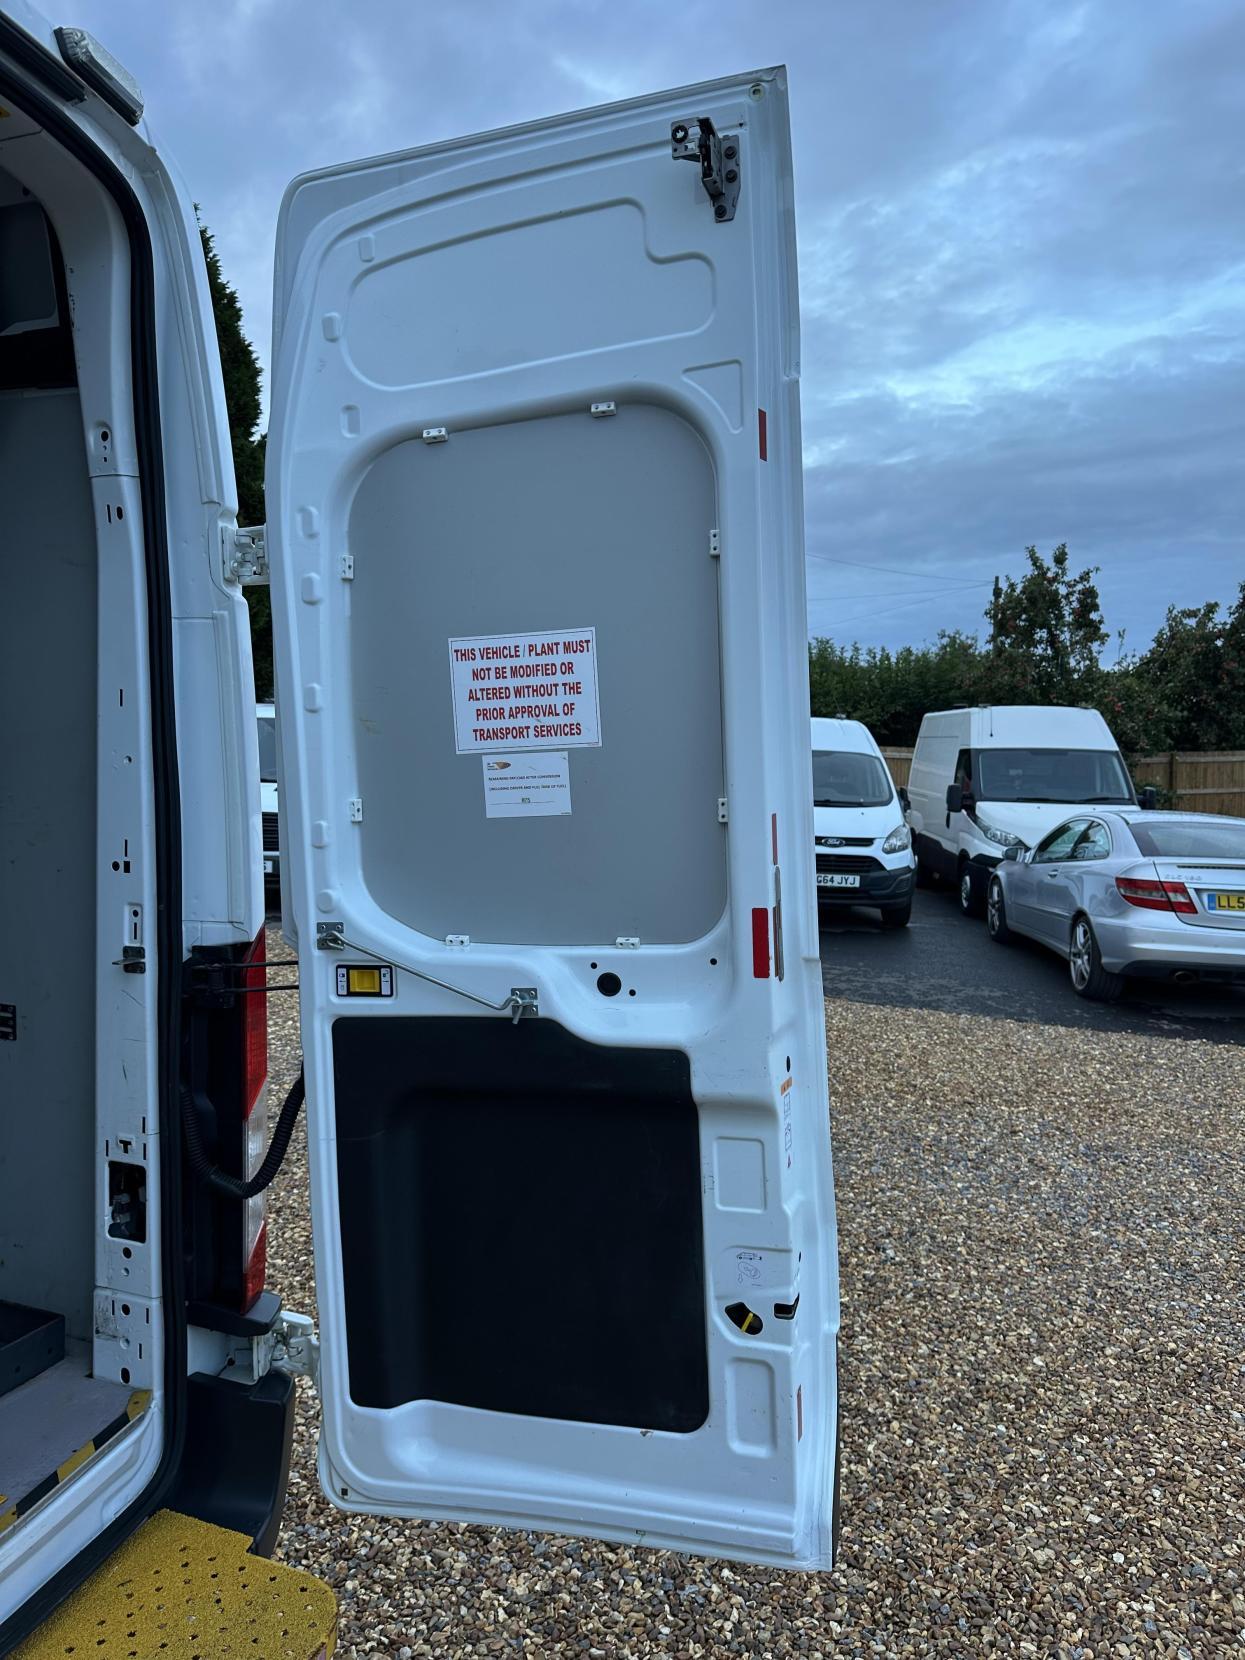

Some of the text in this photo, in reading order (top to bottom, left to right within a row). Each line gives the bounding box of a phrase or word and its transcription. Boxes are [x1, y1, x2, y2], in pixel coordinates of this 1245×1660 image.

[454, 648, 476, 662] THIS
[479, 645, 520, 660] VEHICLE
[528, 642, 560, 657] PLANT
[563, 639, 591, 654] MUST
[472, 662, 574, 681] NOT BE MODIFIED OR
[468, 682, 582, 702] ALTERED WITHOUT THE
[476, 703, 575, 721] PRIOR APPROVAL OF
[473, 722, 582, 741] TRANSPORT SERVICES
[837, 876, 856, 885] JYJ
